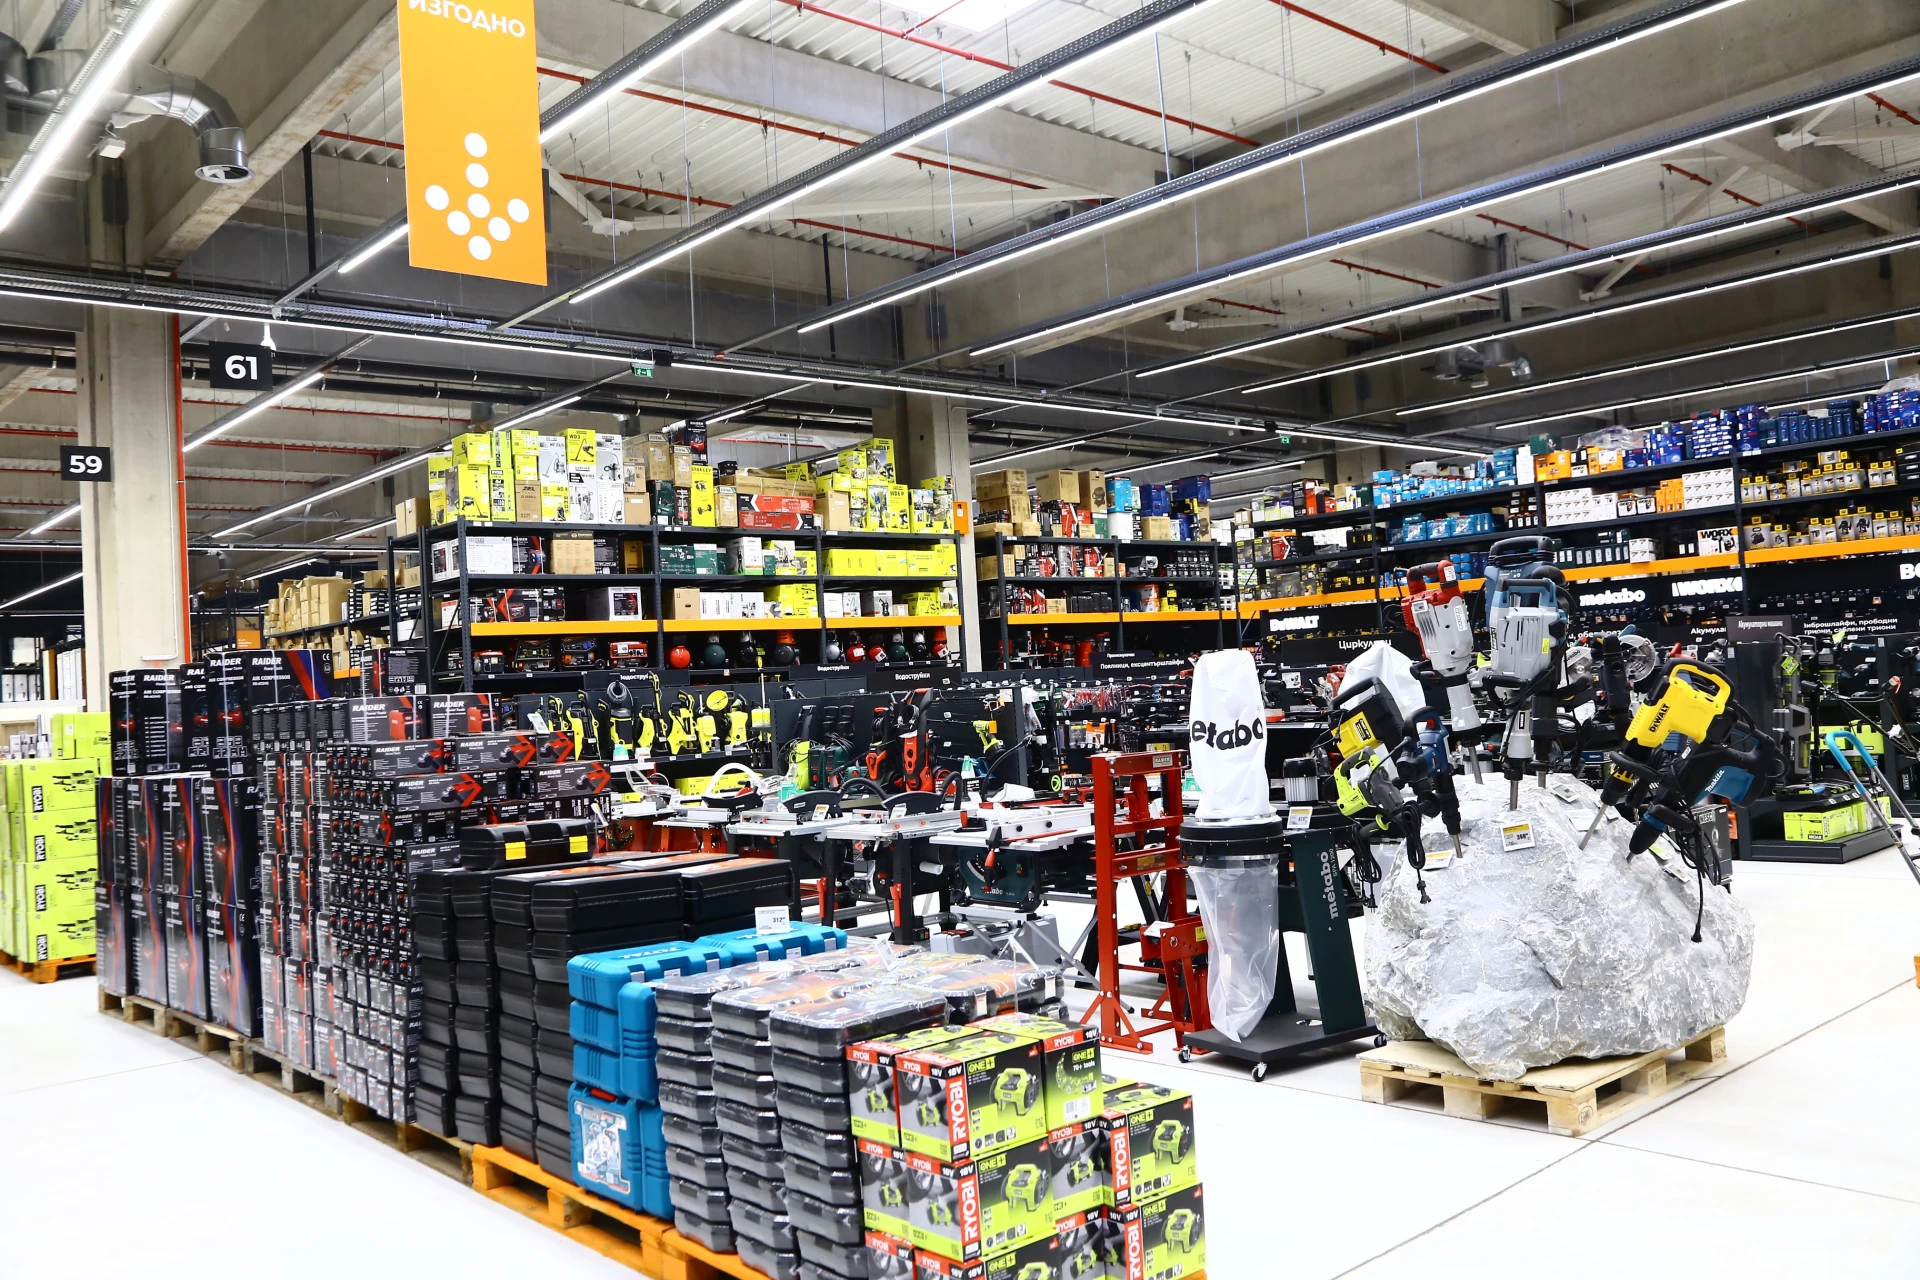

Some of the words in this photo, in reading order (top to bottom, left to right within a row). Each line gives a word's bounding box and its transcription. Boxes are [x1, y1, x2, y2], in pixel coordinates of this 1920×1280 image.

[408, 0, 526, 38] ИЗГОДНО
[225, 355, 258, 380] 61
[69, 455, 103, 474] 59
[1701, 528, 1732, 538] WORX
[1674, 576, 1741, 597] WORX
[1580, 588, 1646, 606] metabo
[1859, 618, 1898, 626] прободни
[1691, 627, 1726, 636] Акумула
[210, 658, 242, 666] RAIDER
[252, 658, 282, 666] RAIDER
[896, 672, 930, 681] Водоструйки
[352, 704, 386, 712] RAIDER
[433, 700, 465, 709] RAIDER
[1190, 718, 1264, 750] etabo
[34, 788, 44, 812] RYOBI
[36, 836, 46, 862] RYOBI
[1320, 851, 1338, 920] metabo
[36, 886, 46, 912] RYOBI
[38, 935, 47, 960] RYOBI
[1054, 1036, 1074, 1047] RYOBI
[1086, 1029, 1098, 1038] 18V
[852, 1050, 870, 1061] RYOBI
[879, 1056, 890, 1064] 18V
[1073, 1062, 1082, 1071] 70+
[1084, 1060, 1096, 1068] tools
[904, 1061, 920, 1072] RYOBI
[931, 1068, 942, 1077] 18V
[948, 1066, 962, 1077] 18V
[950, 1080, 967, 1142] RYOBI
[1052, 1126, 1073, 1140] RYOBI
[1084, 1120, 1096, 1130] 18V
[1112, 1118, 1126, 1128] 18V
[866, 1142, 884, 1154] RYOBI
[892, 1150, 904, 1160] 18V
[1114, 1132, 1129, 1188] RYOBI
[912, 1158, 932, 1172] RYOBI
[942, 1167, 954, 1178] 18V
[960, 1165, 974, 1177] 18V
[962, 1180, 978, 1242] RYOBI
[1109, 1212, 1122, 1222] 18V
[1126, 1210, 1139, 1221] 18V
[1056, 1218, 1076, 1232] RYOBI
[1086, 1210, 1099, 1220] 18V
[872, 1238, 888, 1251] RYOBI
[898, 1248, 909, 1258] 18V
[1128, 1224, 1143, 1280] RYOBI
[922, 1256, 940, 1270] RYOBI
[951, 1268, 963, 1278] 18V
[968, 1266, 983, 1278] 18V
